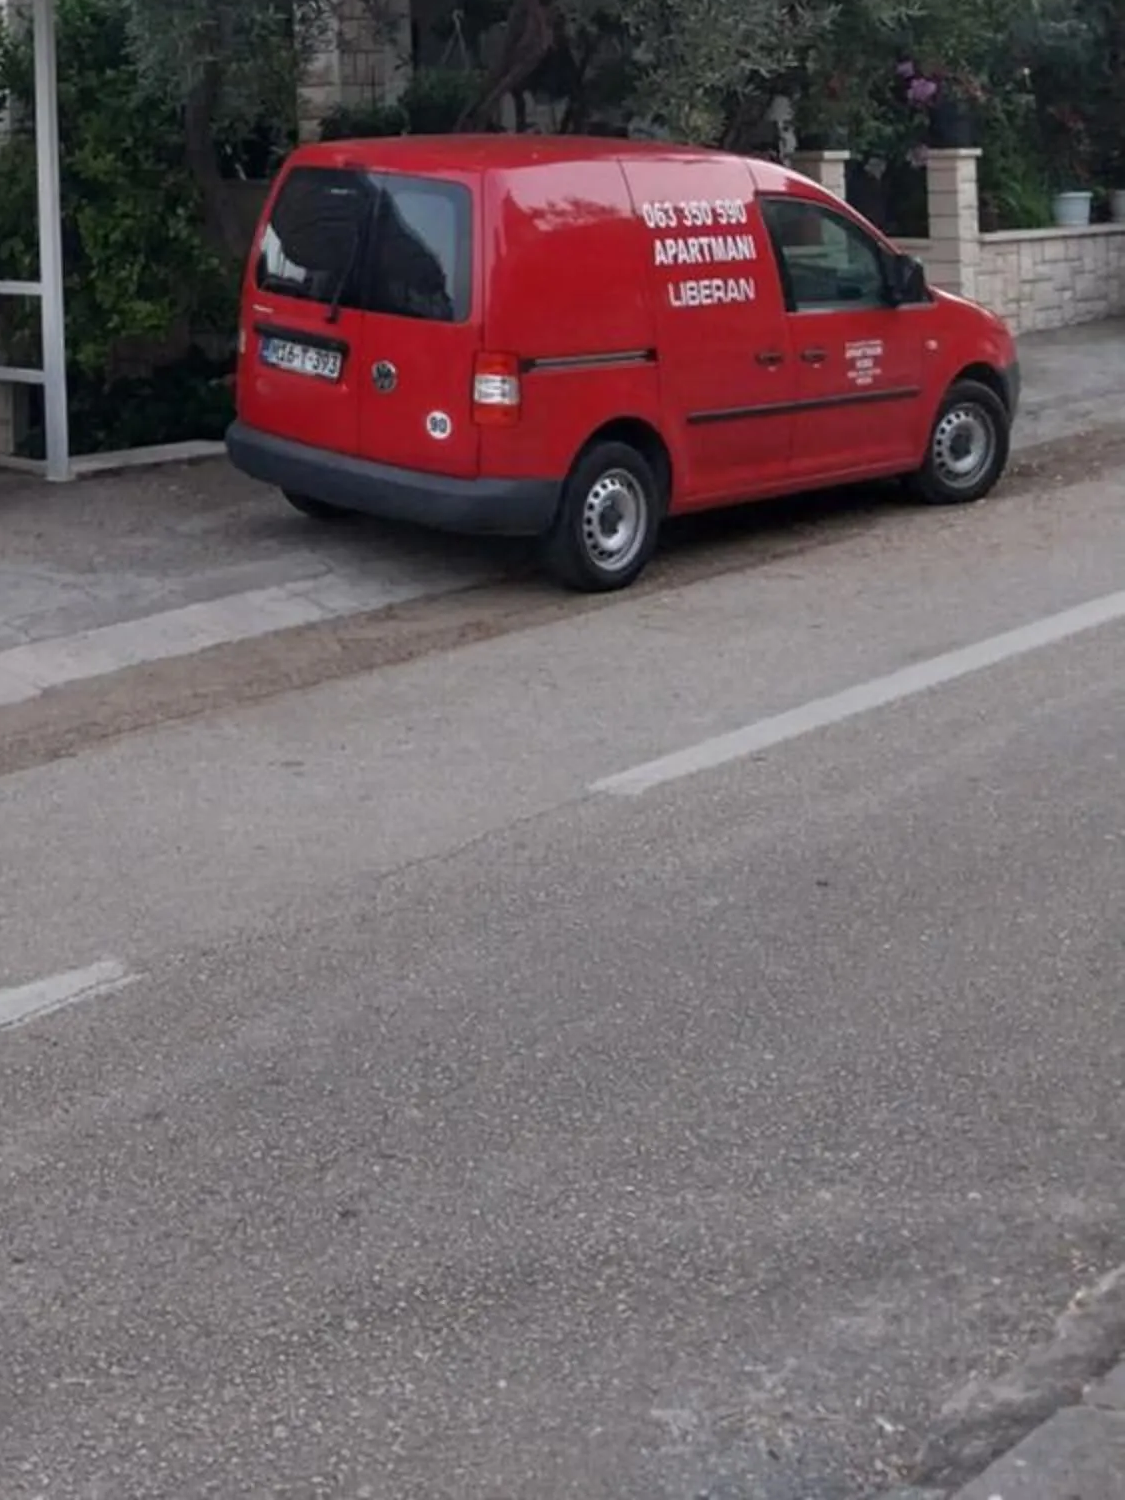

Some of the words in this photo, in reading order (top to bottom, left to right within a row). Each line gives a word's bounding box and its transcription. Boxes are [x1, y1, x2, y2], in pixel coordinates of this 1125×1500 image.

[642, 201, 677, 229] 063
[653, 235, 757, 266] APARTMANI
[667, 277, 756, 308] LIBERAN
[429, 415, 448, 434] 90
